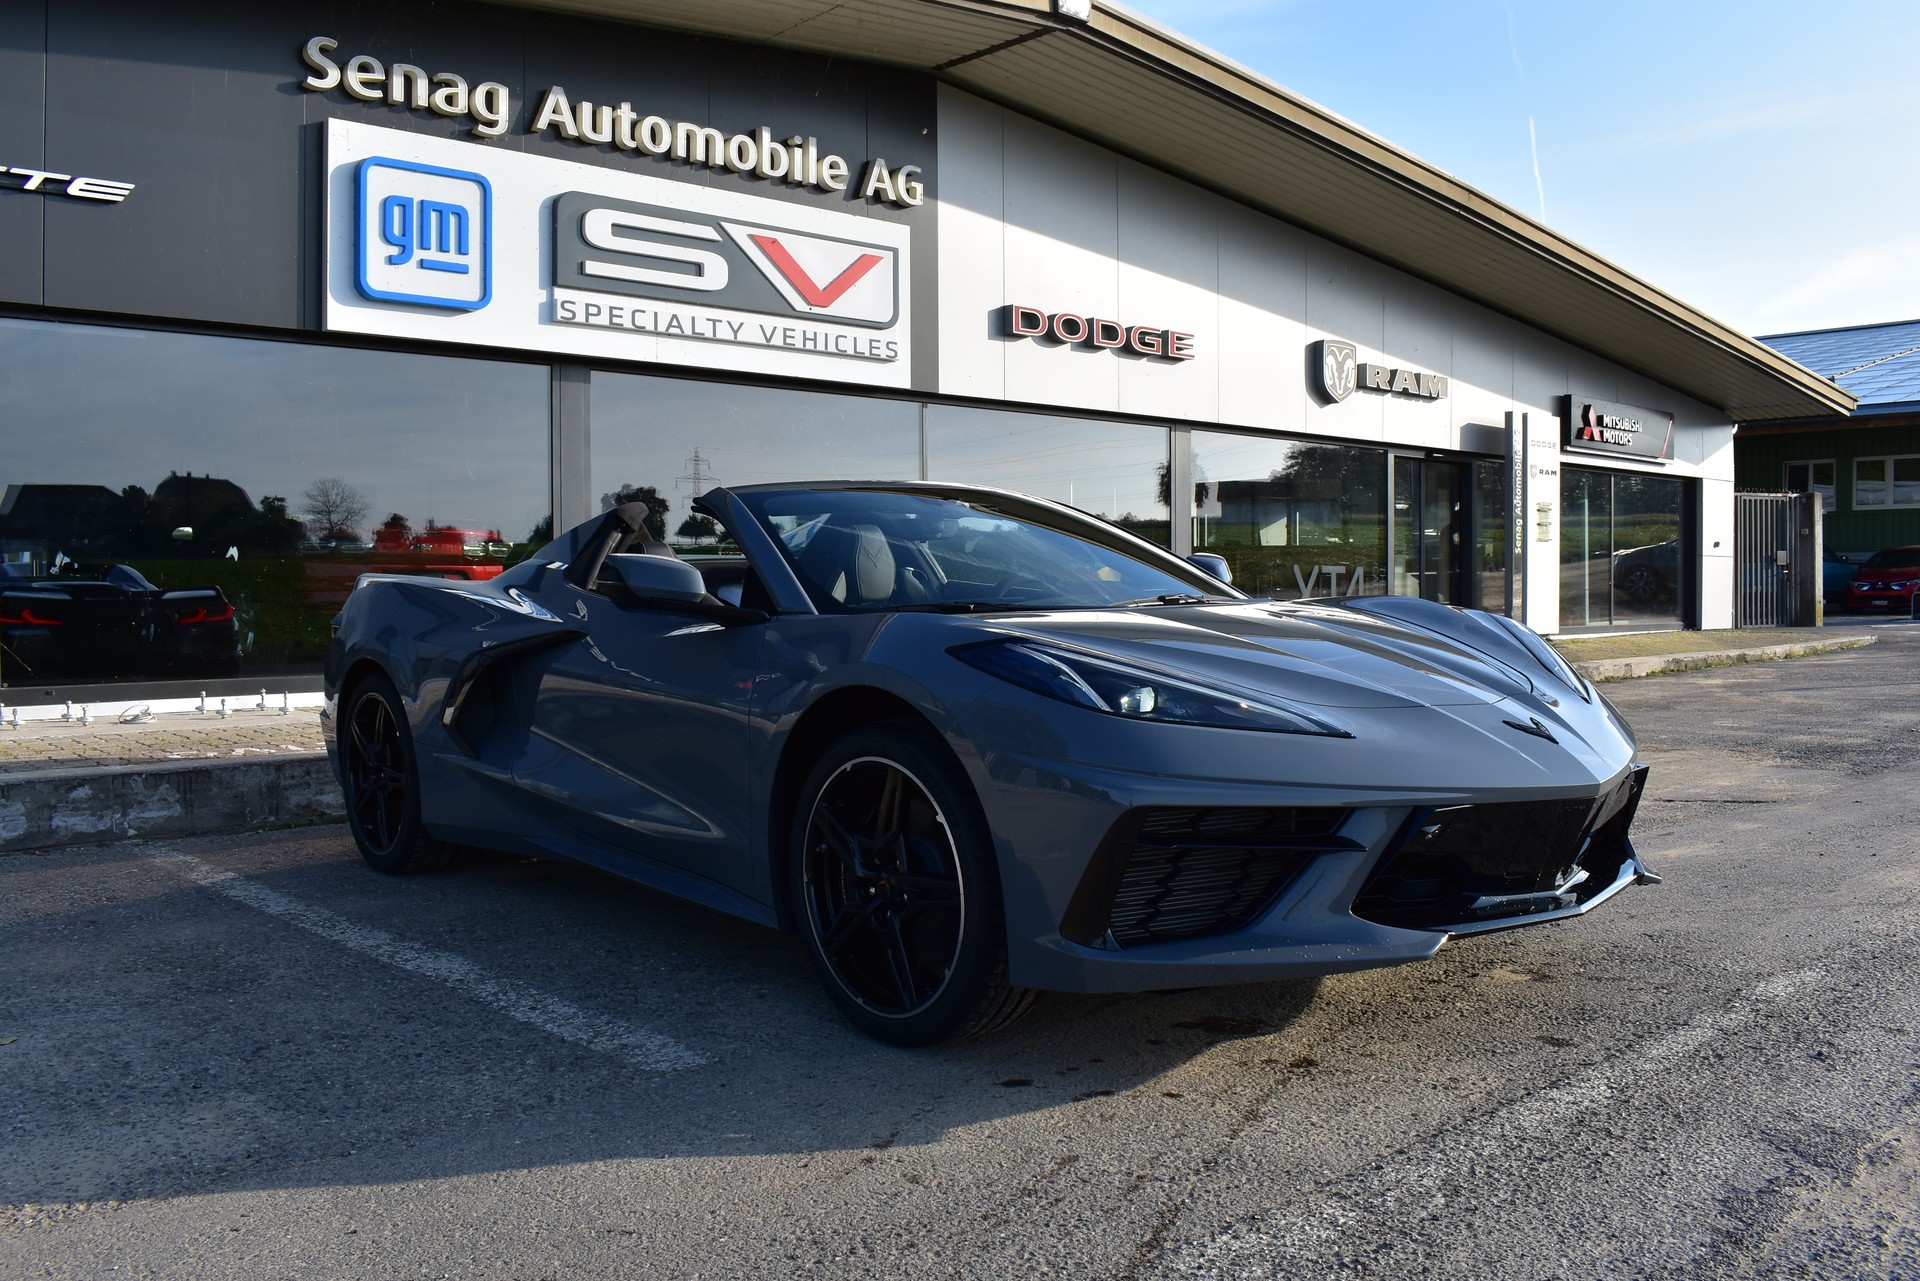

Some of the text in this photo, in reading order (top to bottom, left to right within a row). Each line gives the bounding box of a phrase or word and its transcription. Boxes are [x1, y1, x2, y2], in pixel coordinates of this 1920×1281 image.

[302, 36, 924, 207] Senag Automobile AG
[0, 165, 136, 202] TE
[383, 195, 470, 266] gm
[559, 299, 899, 360] SPECIALTY VEHICLES
[1011, 304, 1195, 360] DODGE
[1364, 363, 1449, 399] RAM
[1603, 414, 1643, 433] MITSUBISHI
[1603, 429, 1633, 446] MOTORS
[1530, 439, 1557, 450] DODGE
[1539, 468, 1558, 477] RAM
